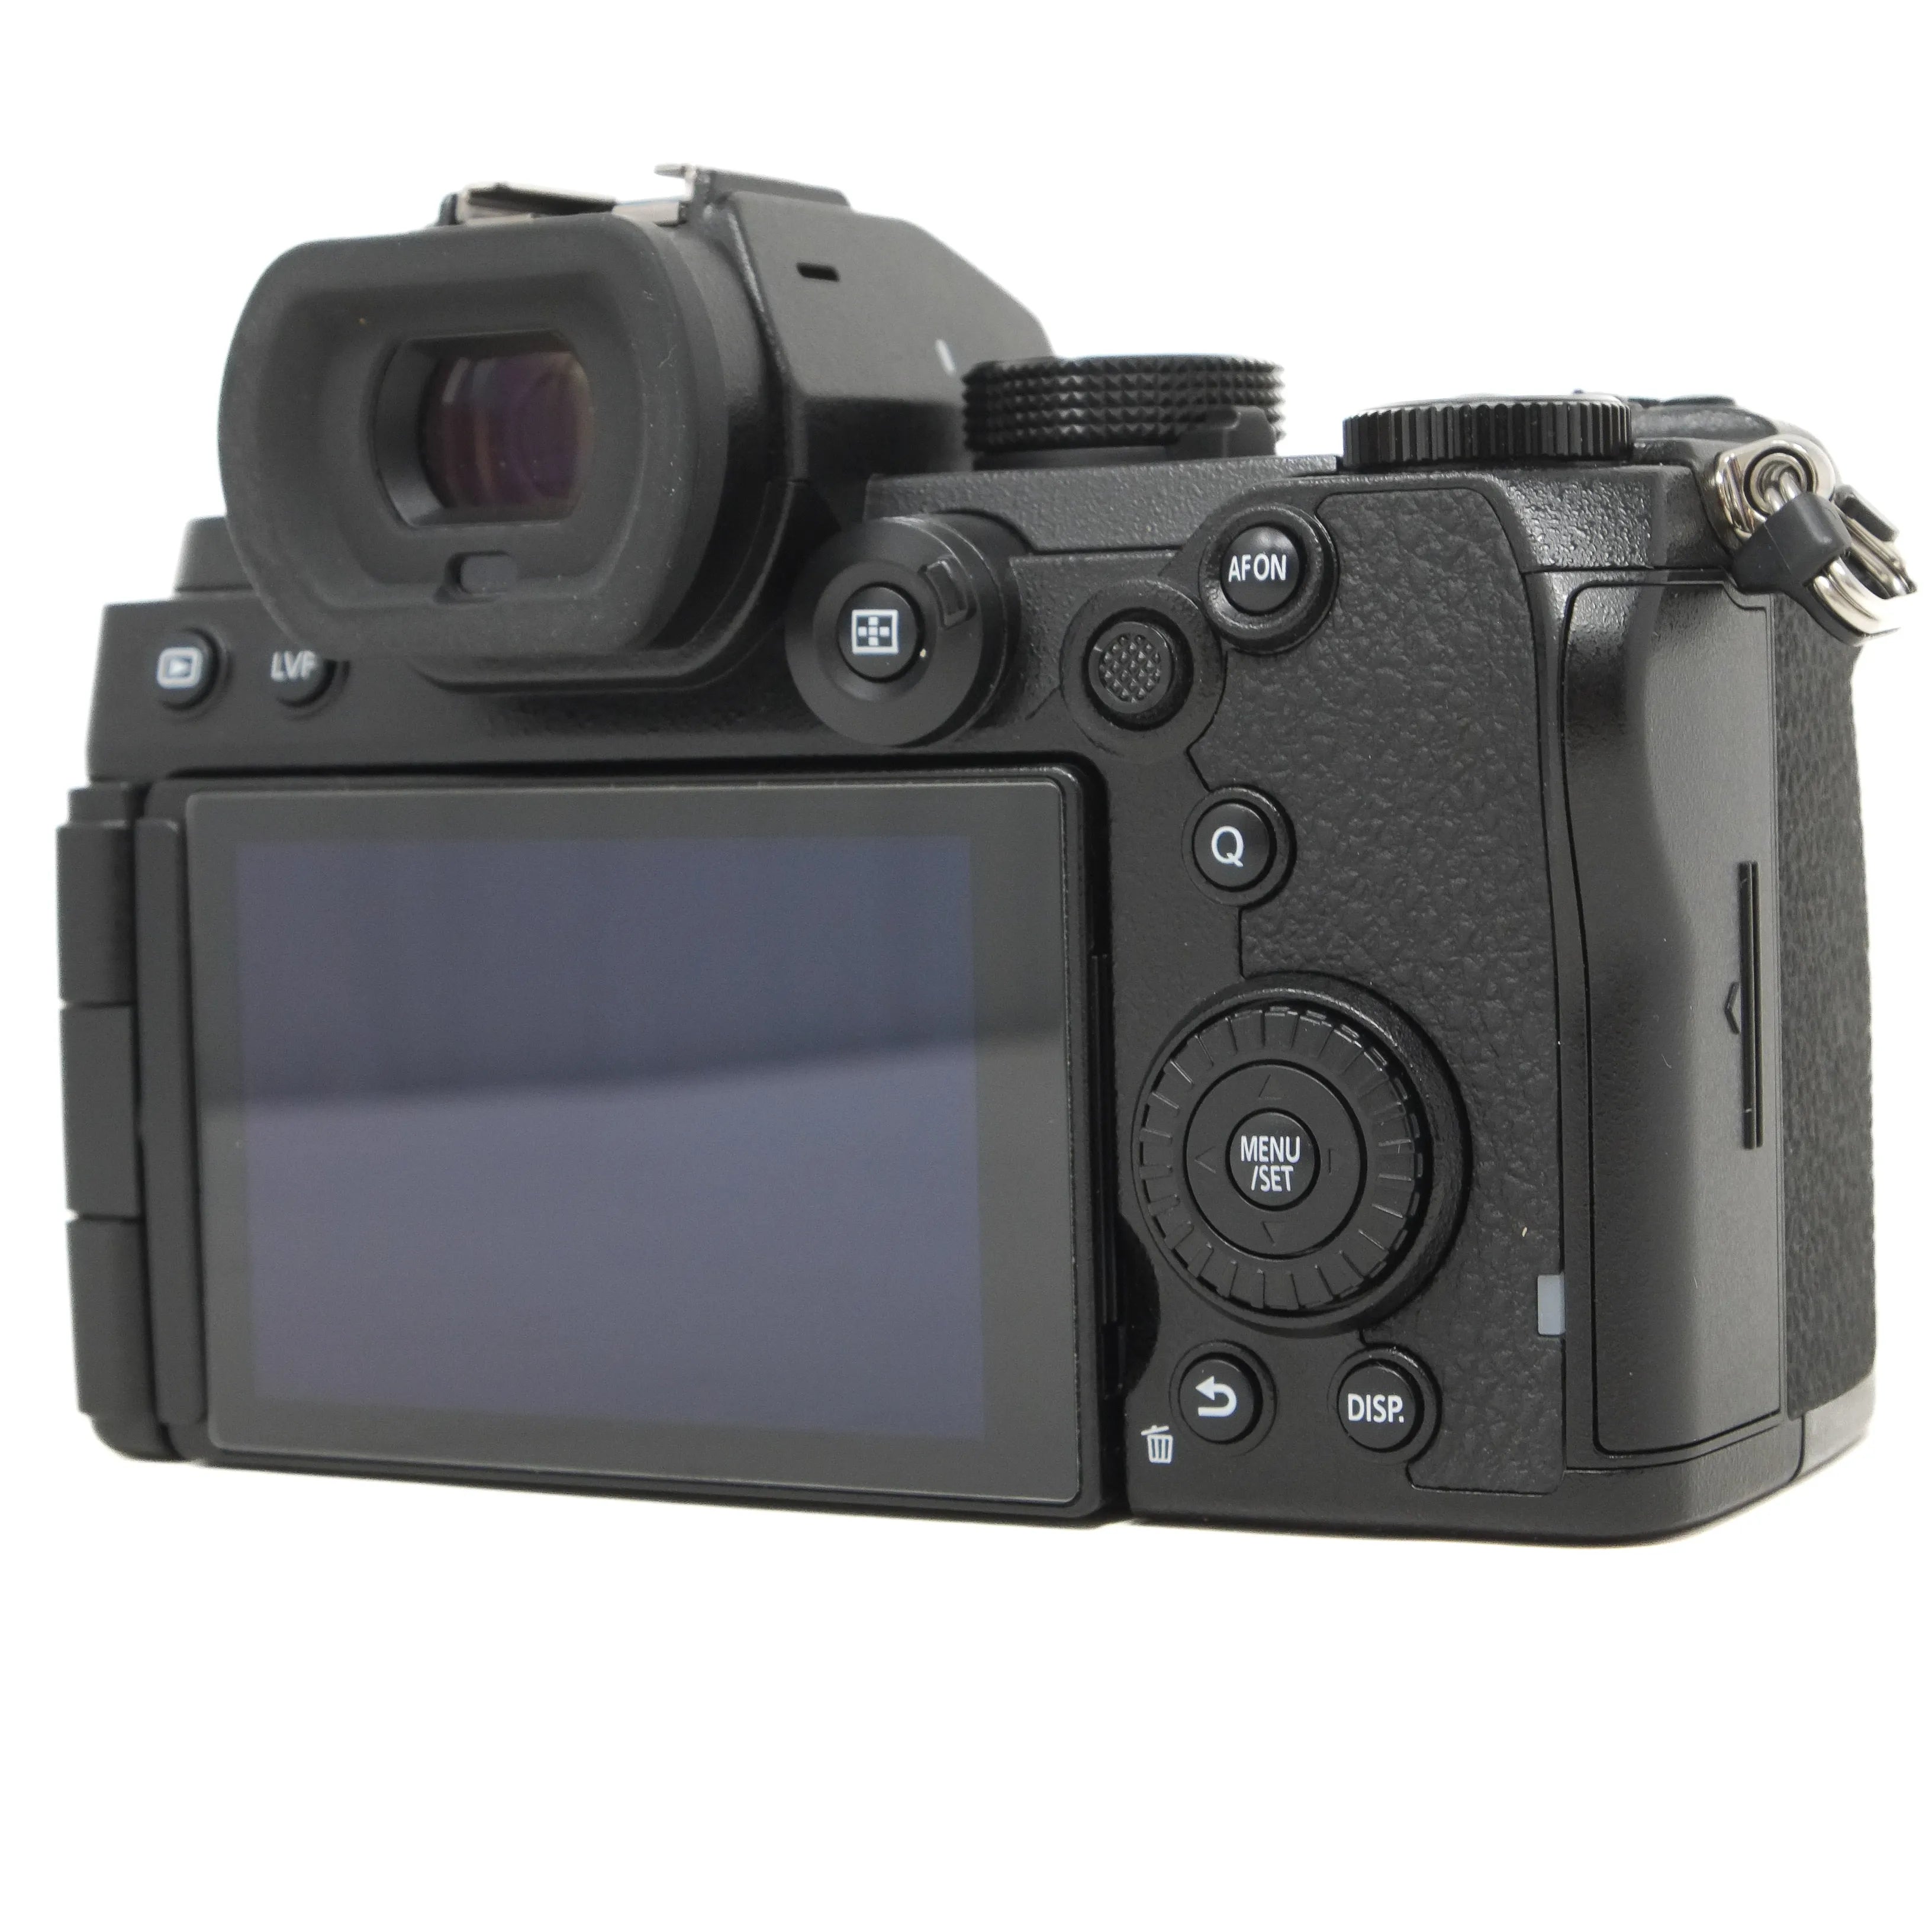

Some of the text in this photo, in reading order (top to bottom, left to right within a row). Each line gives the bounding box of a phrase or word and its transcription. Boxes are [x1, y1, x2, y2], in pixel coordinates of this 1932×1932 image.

[270, 649, 318, 682] LVF
[1211, 825, 1244, 867] Q
[1241, 1135, 1300, 1164] MENU
[1347, 1393, 1404, 1423] DISP.
